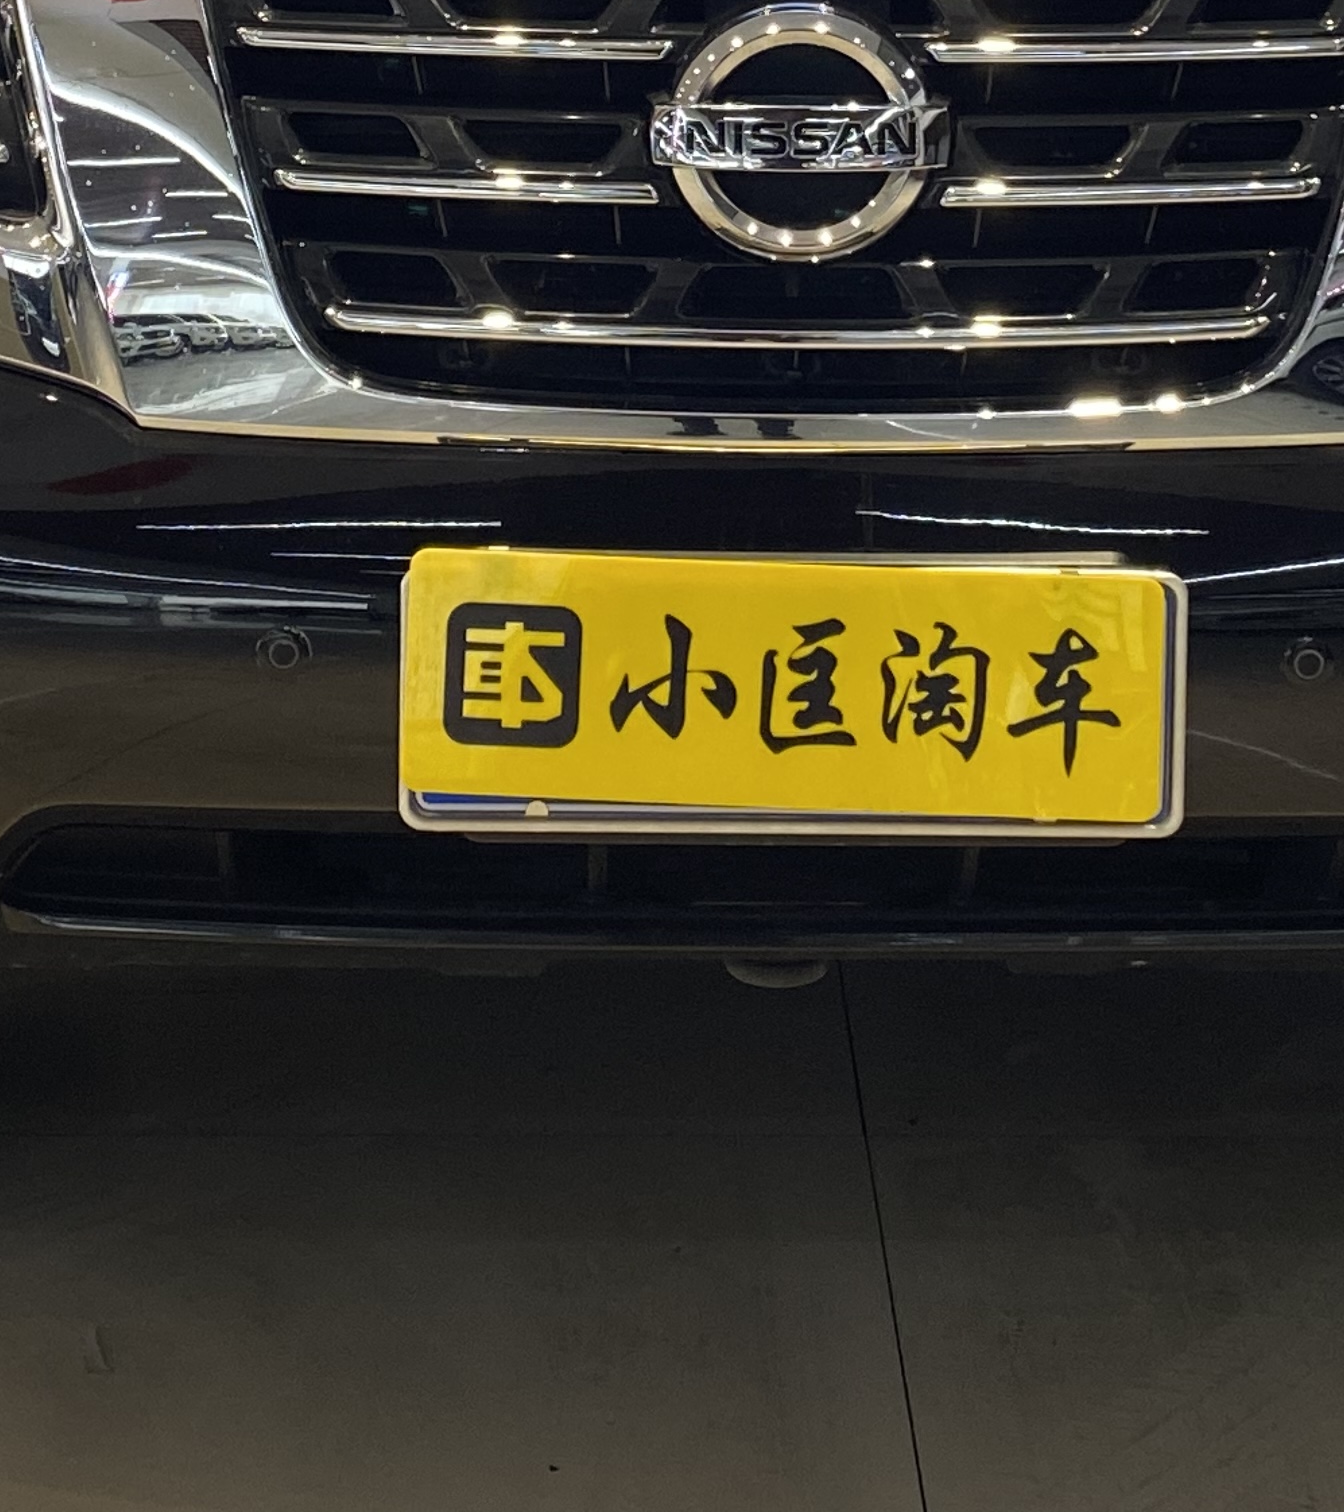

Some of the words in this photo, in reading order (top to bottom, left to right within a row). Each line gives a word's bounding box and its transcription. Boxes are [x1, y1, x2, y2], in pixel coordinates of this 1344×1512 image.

[684, 118, 918, 159] NISSAN
[608, 612, 1122, 777] 小匡淘车
